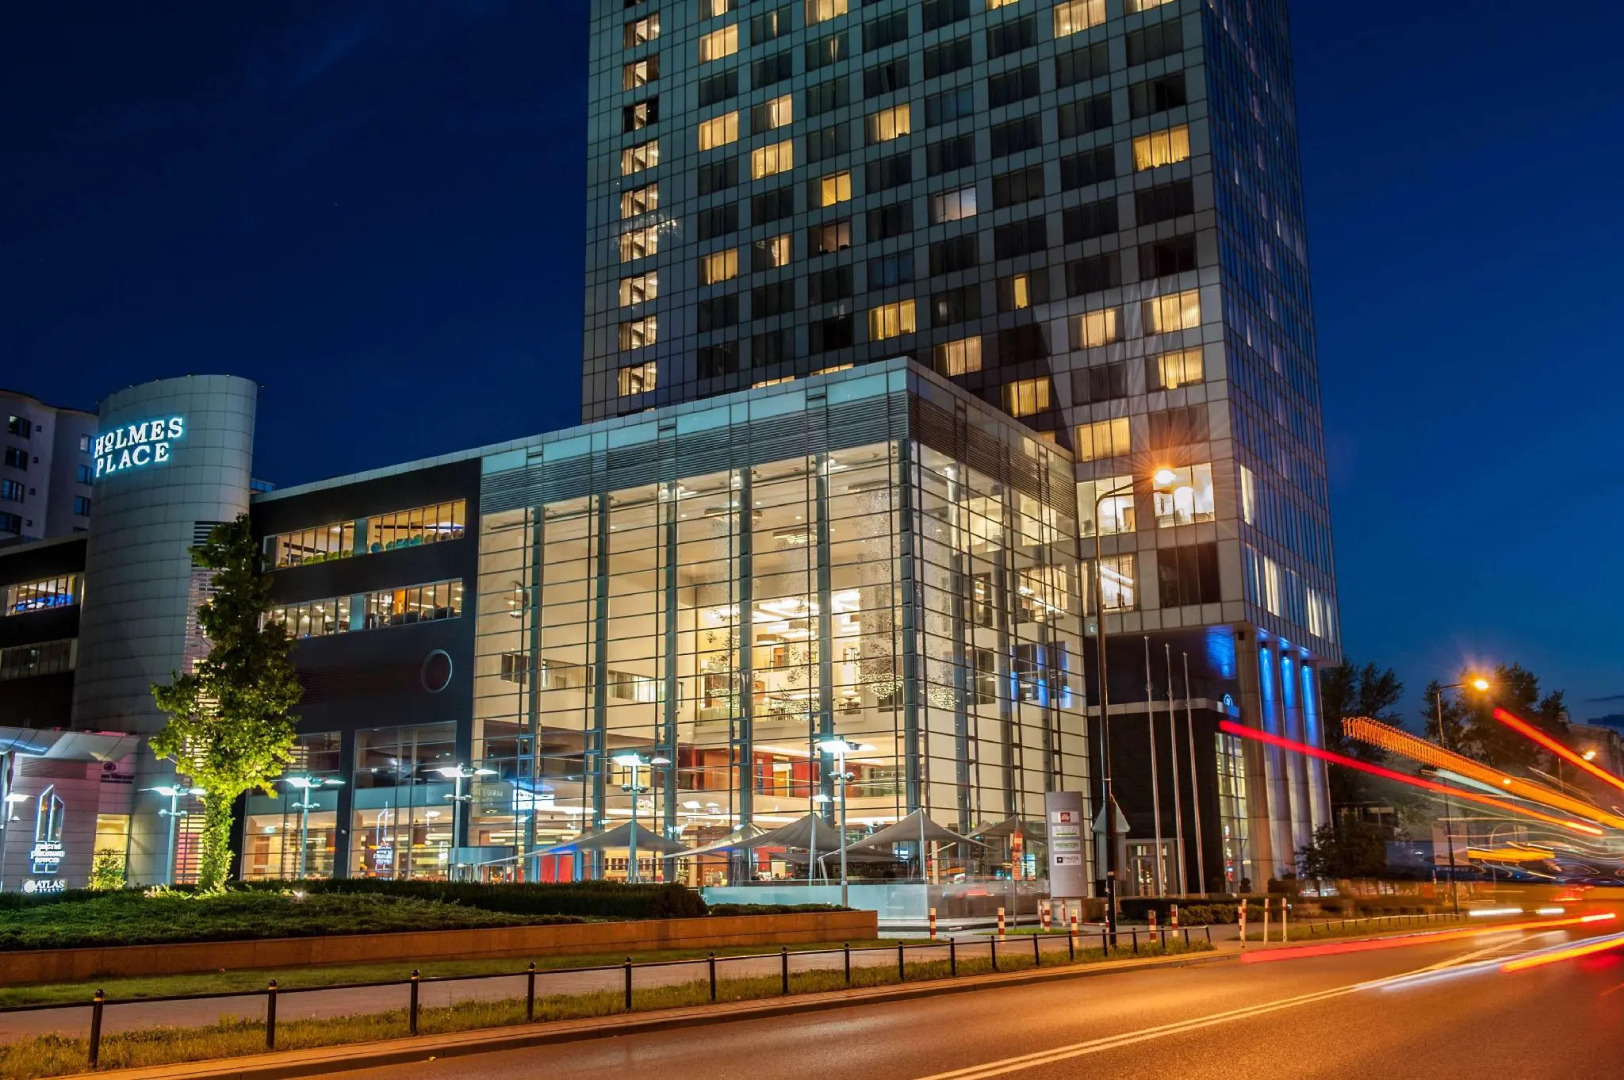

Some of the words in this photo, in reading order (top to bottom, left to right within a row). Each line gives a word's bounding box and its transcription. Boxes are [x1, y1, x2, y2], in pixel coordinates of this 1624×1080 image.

[94, 417, 183, 459] HOLMES
[95, 442, 169, 478] PLACE
[35, 880, 65, 889] ATLAS
